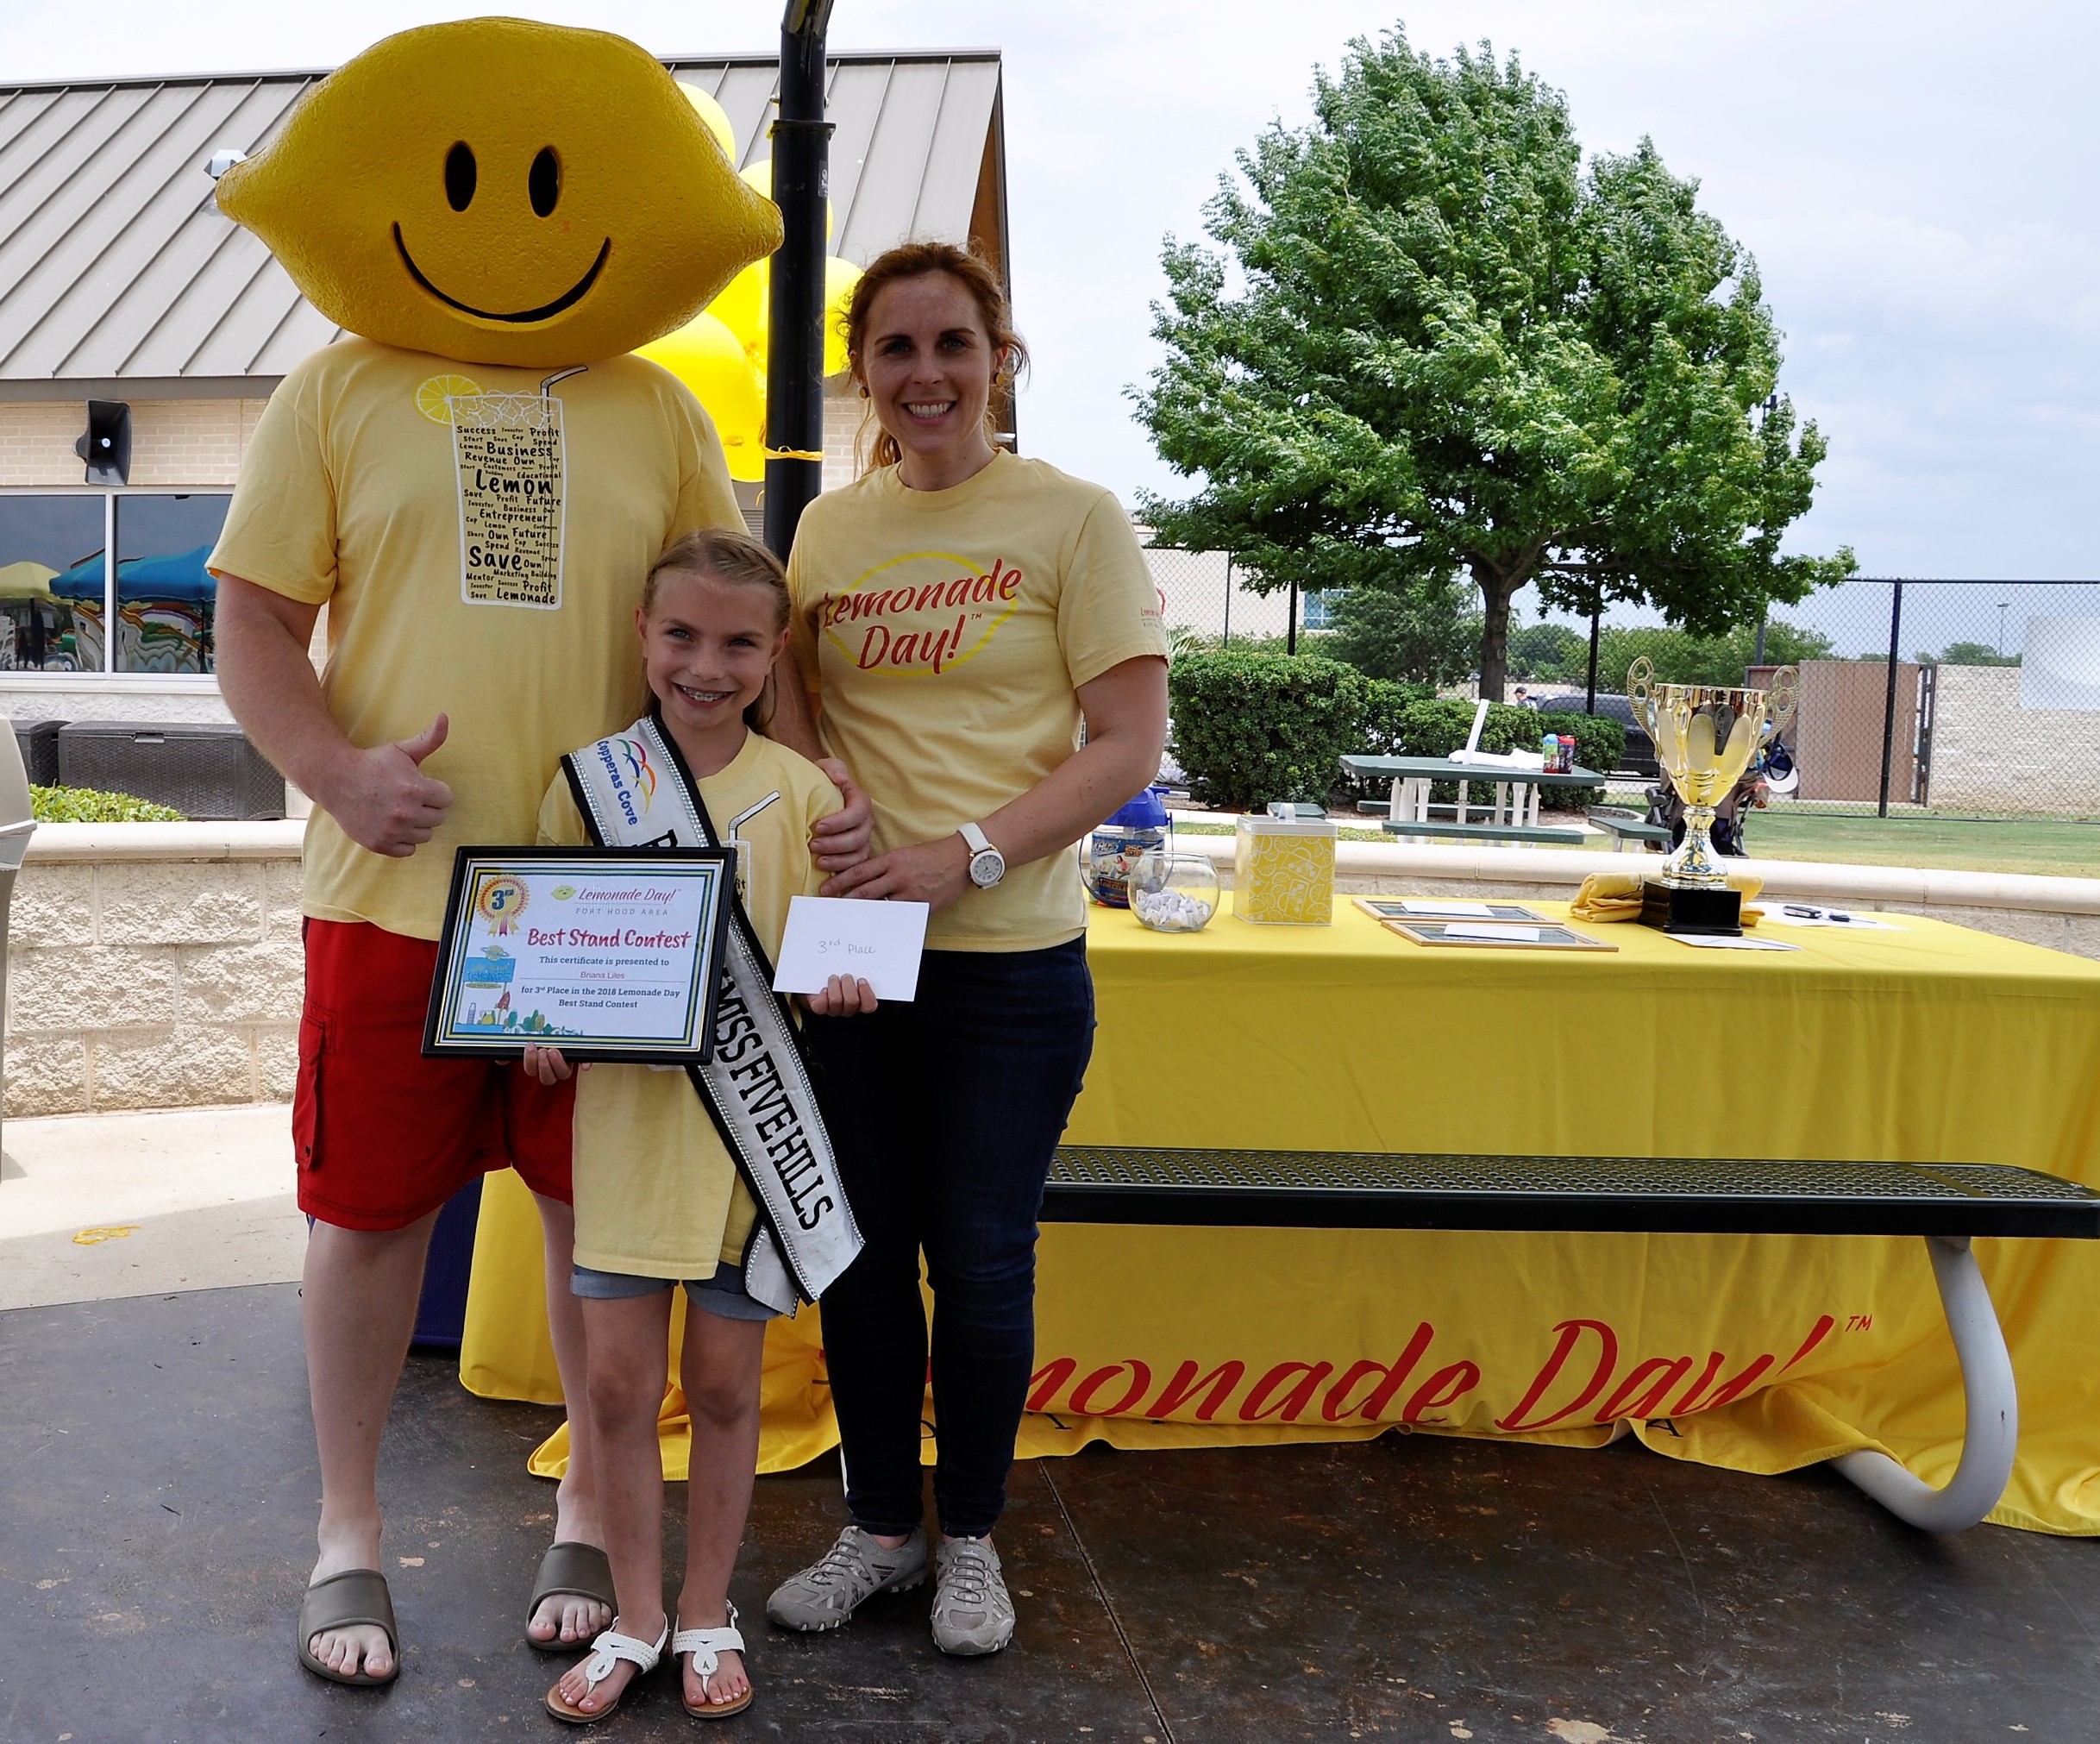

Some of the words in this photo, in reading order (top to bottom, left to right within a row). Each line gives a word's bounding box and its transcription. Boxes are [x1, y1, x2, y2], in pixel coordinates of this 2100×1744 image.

[457, 426, 496, 435] Success
[530, 427, 560, 437] Profit
[486, 441, 553, 457] Business
[533, 438, 557, 447] Spend
[465, 452, 507, 465] Revenue
[514, 456, 535, 466] Own
[475, 468, 553, 495] Lemon
[517, 471, 561, 480] Educational
[463, 488, 483, 498] Save
[497, 494, 518, 503] Profit
[526, 494, 561, 506] Future
[468, 499, 494, 508] Investor
[503, 504, 536, 513] Business
[480, 508, 548, 524] Entrepreneur
[485, 521, 506, 530] Lemon
[488, 530, 509, 541] Own
[512, 527, 547, 539] Future
[485, 540, 510, 551] Spend
[468, 545, 523, 571] Save
[523, 559, 542, 568] Own
[466, 573, 495, 581] Mentor
[493, 568, 530, 580] Marketing
[530, 570, 557, 580] Building
[523, 580, 553, 593] Profit
[823, 557, 1024, 630] Lemonade
[497, 587, 555, 605] Lemonade
[856, 613, 966, 675] Day!
[597, 740, 624, 789] Copperas
[617, 790, 638, 825] Cove
[578, 888, 642, 901] Lemonade
[643, 888, 677, 905] Day!
[607, 907, 635, 916] HOOD
[527, 927, 566, 946] Best
[568, 927, 620, 948] Stand
[624, 929, 692, 949] Contest
[560, 956, 604, 965] certificate
[605, 957, 613, 965] is
[615, 957, 659, 967] presented
[607, 971, 625, 980] Liles
[521, 986, 533, 994] for
[547, 987, 569, 995] Place
[581, 987, 596, 995] the
[597, 988, 617, 996] 2018
[617, 988, 661, 997] Lemonade
[663, 988, 680, 999] Day
[559, 999, 578, 1007] Best
[579, 999, 604, 1007] Stand
[605, 1000, 638, 1009] Contest
[715, 965, 764, 1063] MISS
[1024, 1321, 1482, 1425] onade
